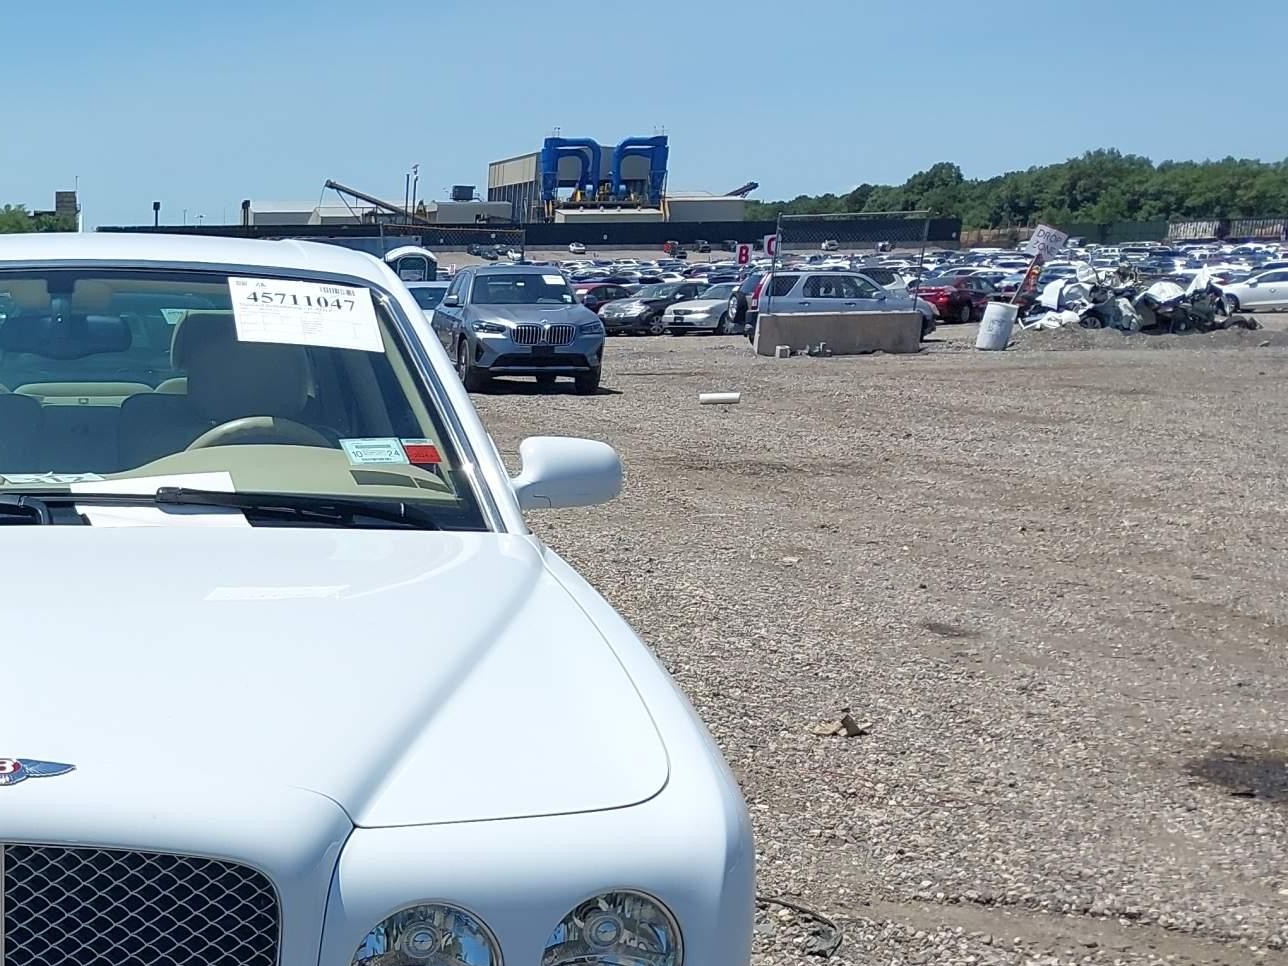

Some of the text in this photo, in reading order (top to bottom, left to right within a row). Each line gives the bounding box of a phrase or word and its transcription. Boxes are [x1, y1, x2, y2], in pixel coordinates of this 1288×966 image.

[1037, 228, 1062, 243] DROP
[738, 245, 749, 264] B
[1032, 241, 1058, 257] ZONE
[246, 291, 355, 312] 45711047
